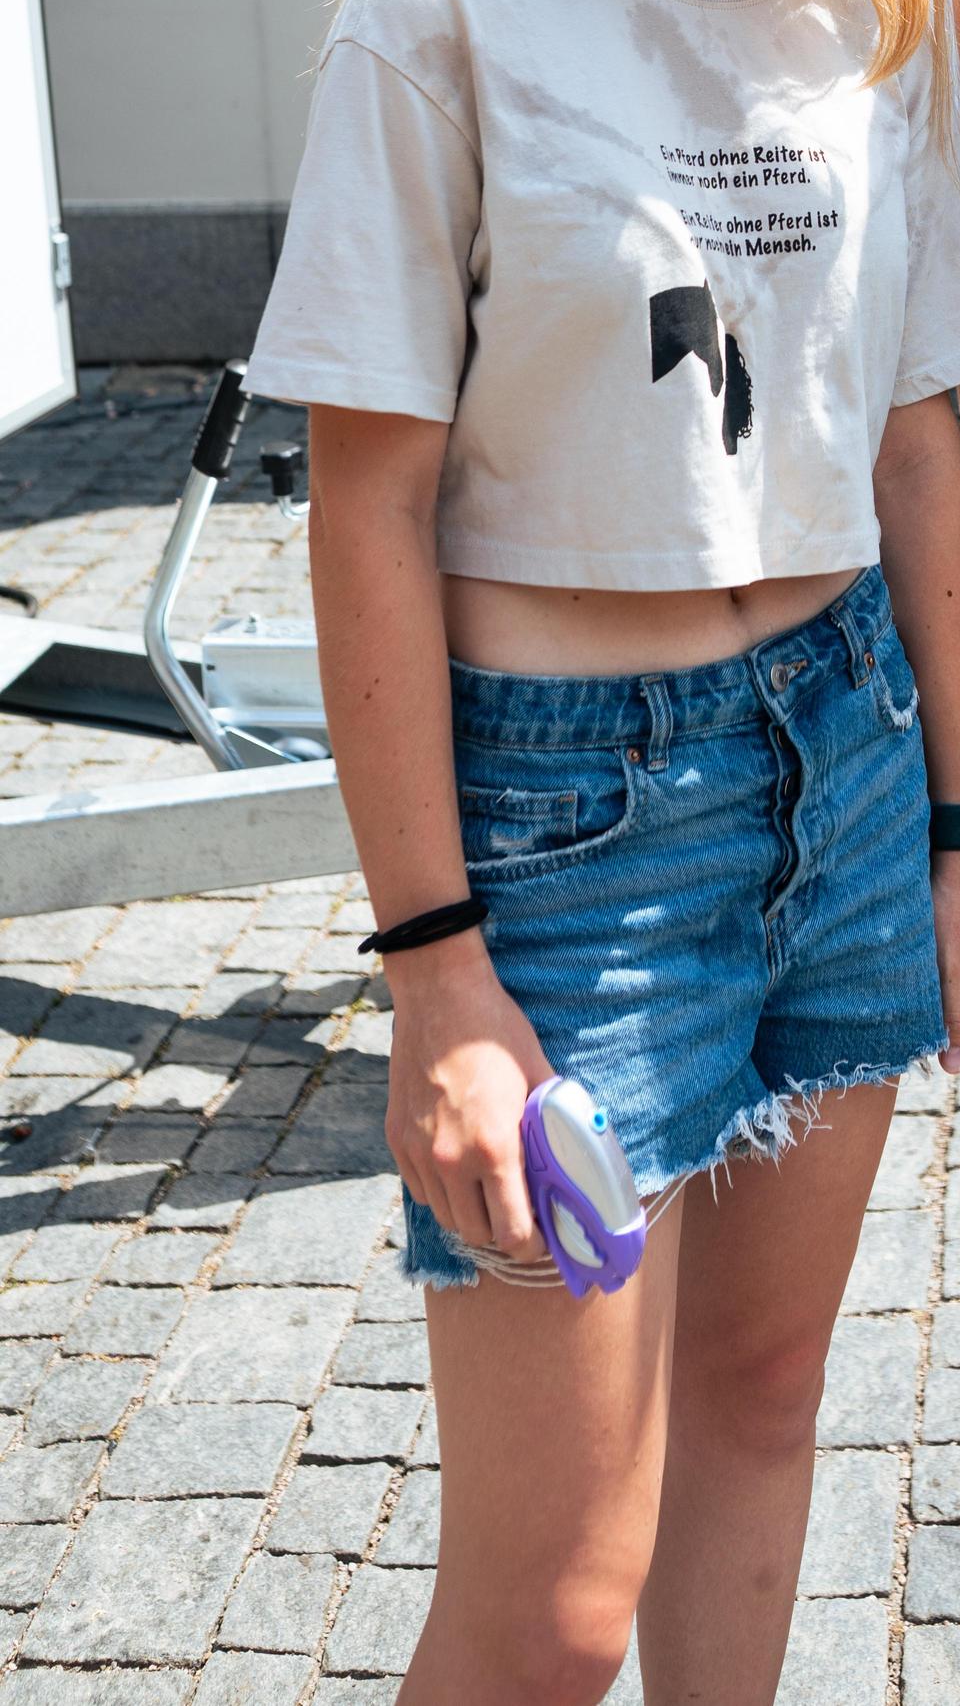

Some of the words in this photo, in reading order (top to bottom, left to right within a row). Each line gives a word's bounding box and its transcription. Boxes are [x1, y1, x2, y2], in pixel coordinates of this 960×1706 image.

[660, 144, 676, 162] Ein
[676, 148, 705, 167] Pferd
[710, 149, 749, 167] ohne
[753, 145, 804, 164] Reiter
[807, 147, 827, 164] ist
[733, 170, 758, 188] ein
[763, 167, 811, 187] Pferd.
[680, 209, 696, 227] Ein
[695, 211, 723, 233] Reiter
[726, 216, 763, 234] ohne
[767, 211, 813, 231] Pferd
[816, 209, 839, 228] ist
[745, 233, 817, 257] Mensch.
